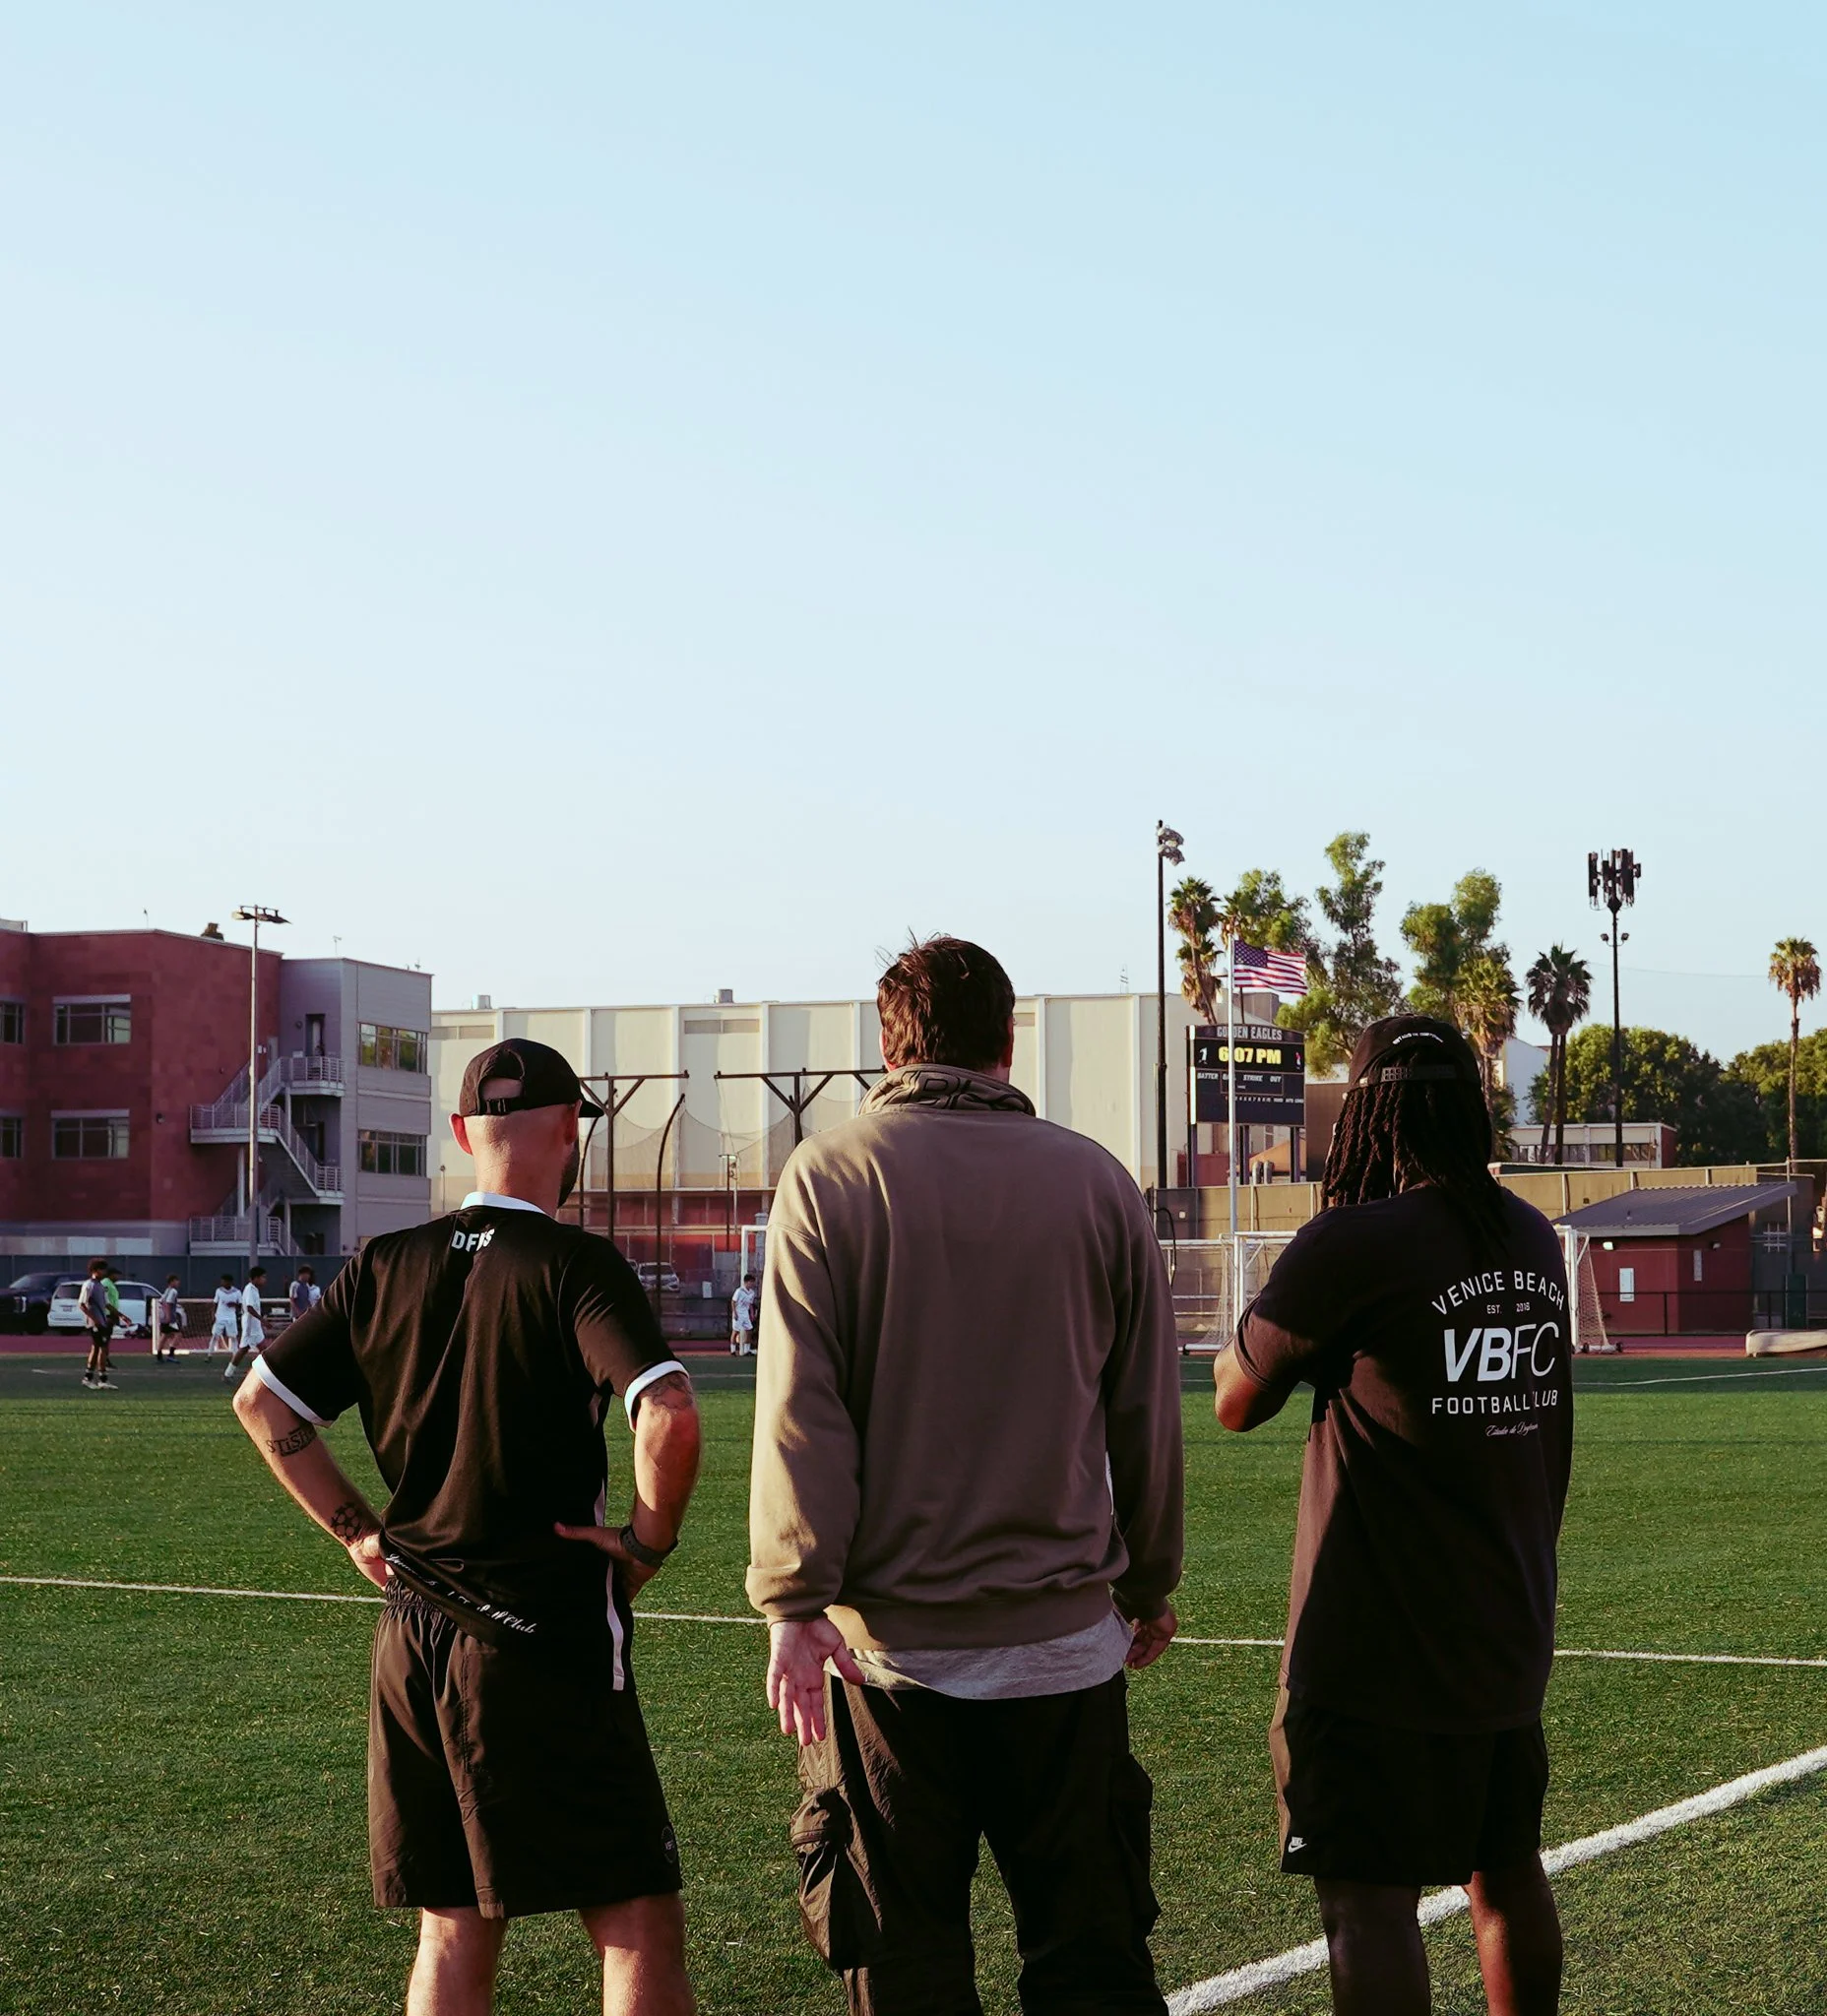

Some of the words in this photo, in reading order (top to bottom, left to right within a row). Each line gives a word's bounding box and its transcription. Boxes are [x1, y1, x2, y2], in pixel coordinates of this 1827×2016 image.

[1217, 1026, 1248, 1040] GODEN
[1250, 1026, 1282, 1040] EAGLES
[1218, 1046, 1254, 1063] 607
[1256, 1048, 1282, 1064] PM
[1431, 1271, 1505, 1315] VENICE
[1514, 1270, 1564, 1311] BEACH
[1444, 1322, 1559, 1382] VBFC
[1432, 1394, 1530, 1415] FOOTBALL
[1533, 1389, 1558, 1408] LUB
